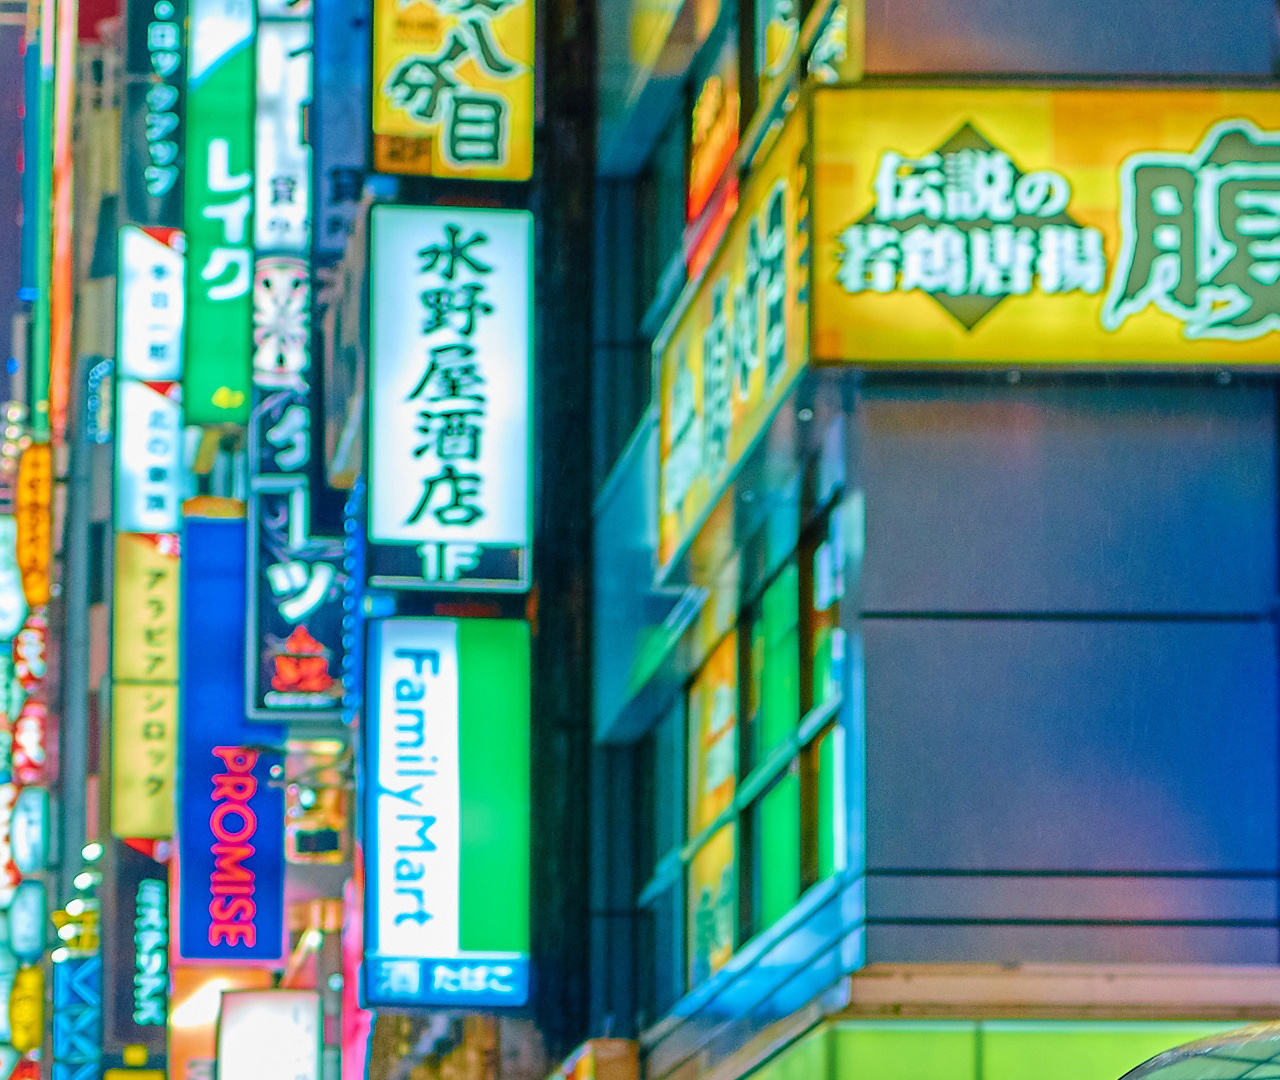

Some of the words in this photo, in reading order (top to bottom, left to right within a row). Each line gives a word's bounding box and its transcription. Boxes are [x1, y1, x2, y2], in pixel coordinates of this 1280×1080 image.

[390, 0, 514, 161] 八分目
[201, 137, 252, 300] レイク
[835, 222, 1107, 296] 若鶏唐揚
[874, 148, 1071, 222] 伝説の
[407, 222, 495, 529] 水野屋酒店
[420, 542, 484, 582] 1F
[142, 566, 168, 800] アラビアンロック
[208, 745, 259, 951] PROMISE
[382, 647, 441, 928] FamilyMart
[433, 962, 514, 994] たばこ
